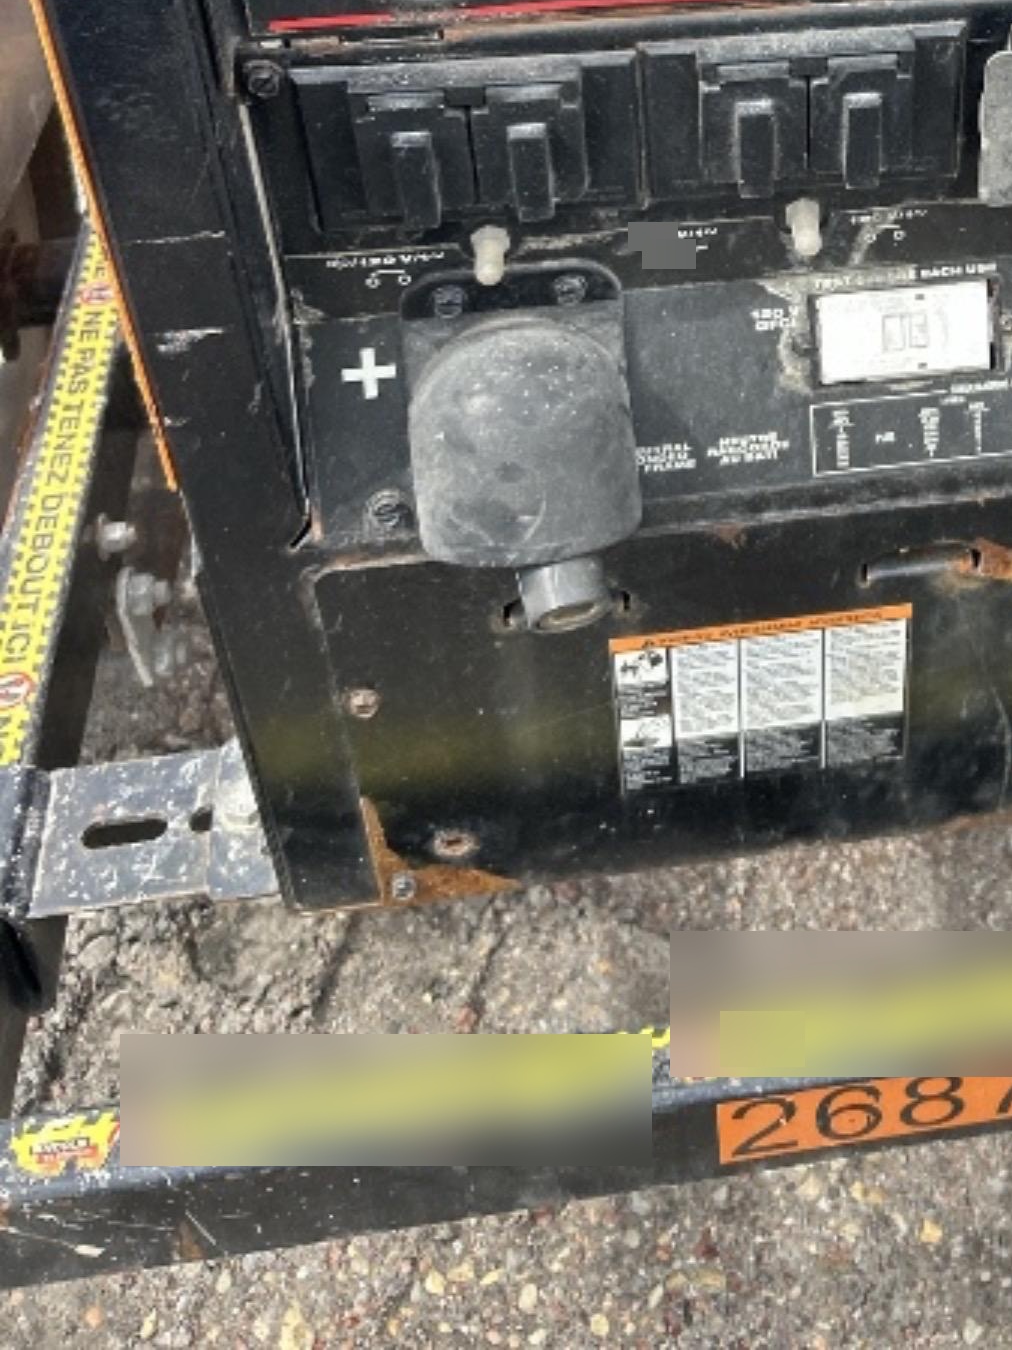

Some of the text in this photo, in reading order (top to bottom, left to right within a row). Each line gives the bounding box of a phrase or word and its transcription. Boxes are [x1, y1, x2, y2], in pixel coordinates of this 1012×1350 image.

[79, 310, 105, 344] NE
[67, 346, 96, 396] PAS
[44, 399, 85, 488] TENEZ
[11, 492, 64, 617] DEBOUT
[1, 620, 31, 664] ICI
